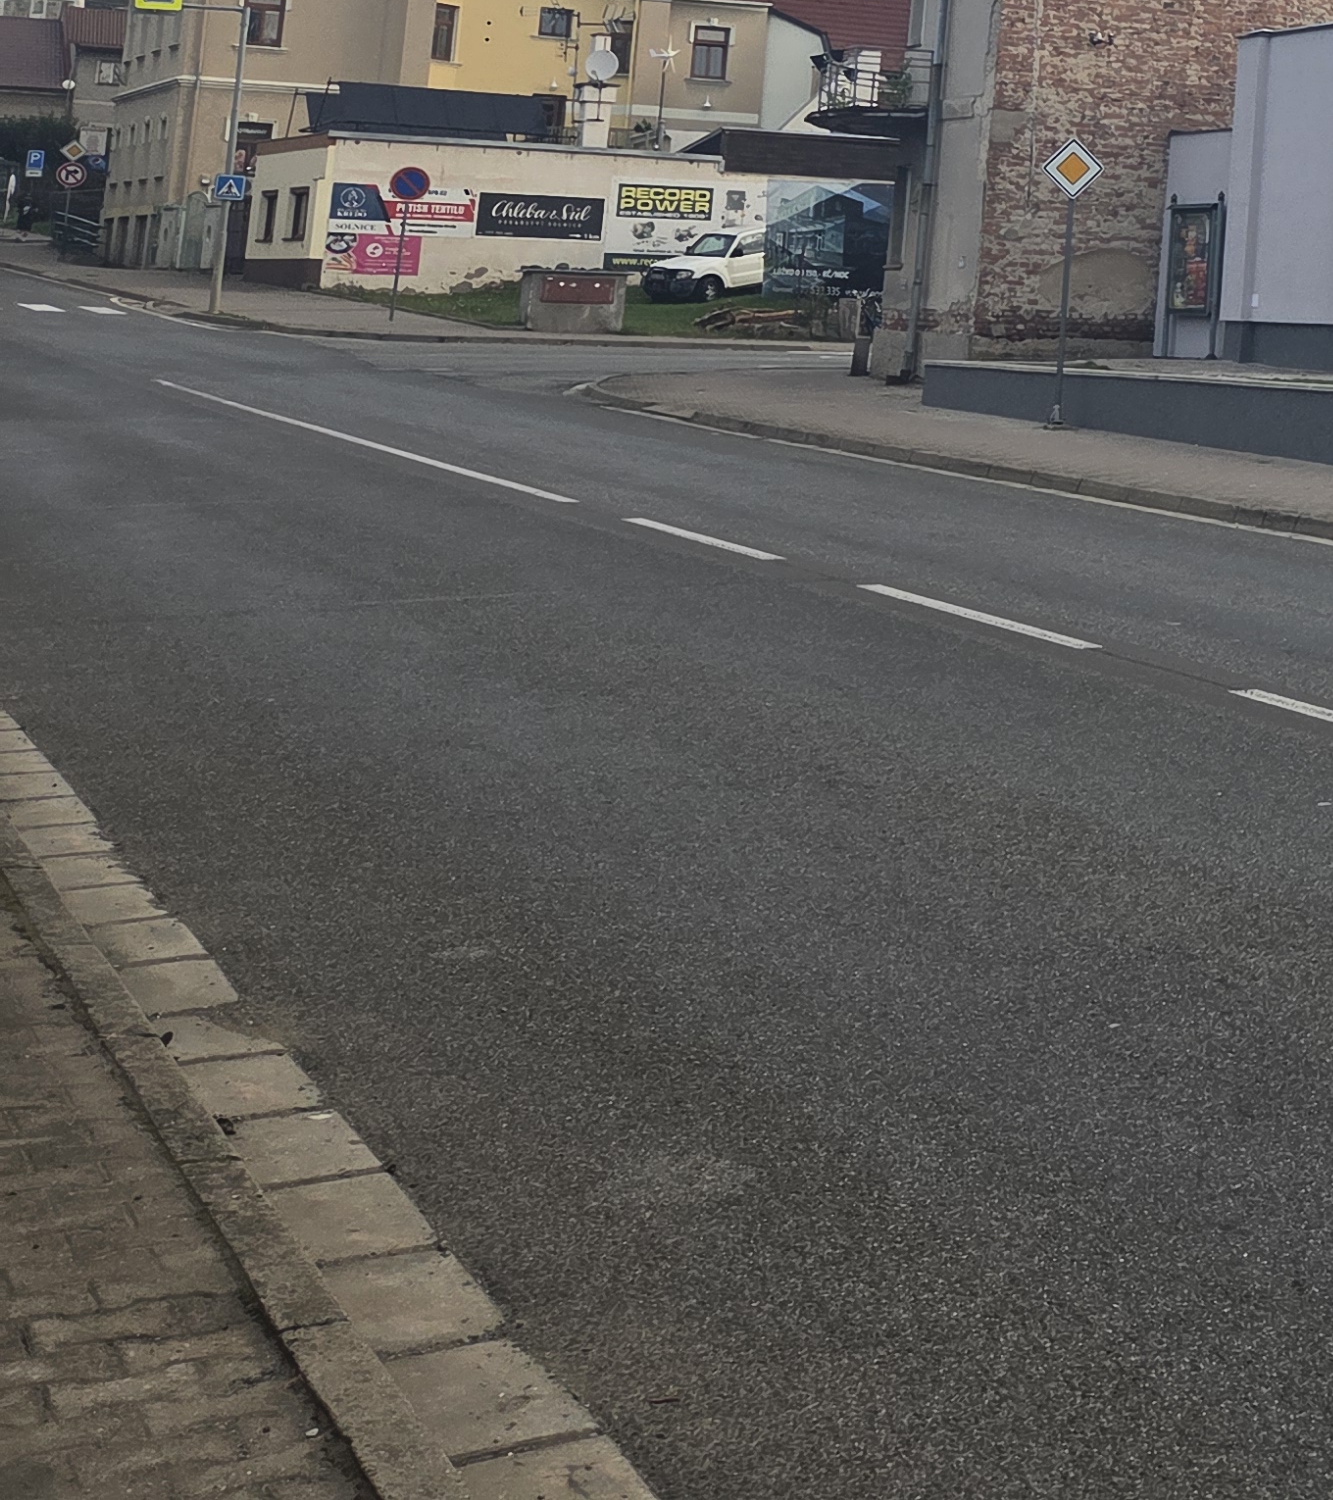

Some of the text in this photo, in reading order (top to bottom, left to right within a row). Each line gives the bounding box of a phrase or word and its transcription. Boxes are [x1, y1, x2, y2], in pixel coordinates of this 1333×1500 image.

[30, 152, 41, 164] P
[621, 186, 711, 202] RECORD
[491, 199, 550, 219] Chleba
[620, 198, 711, 214] POWER
